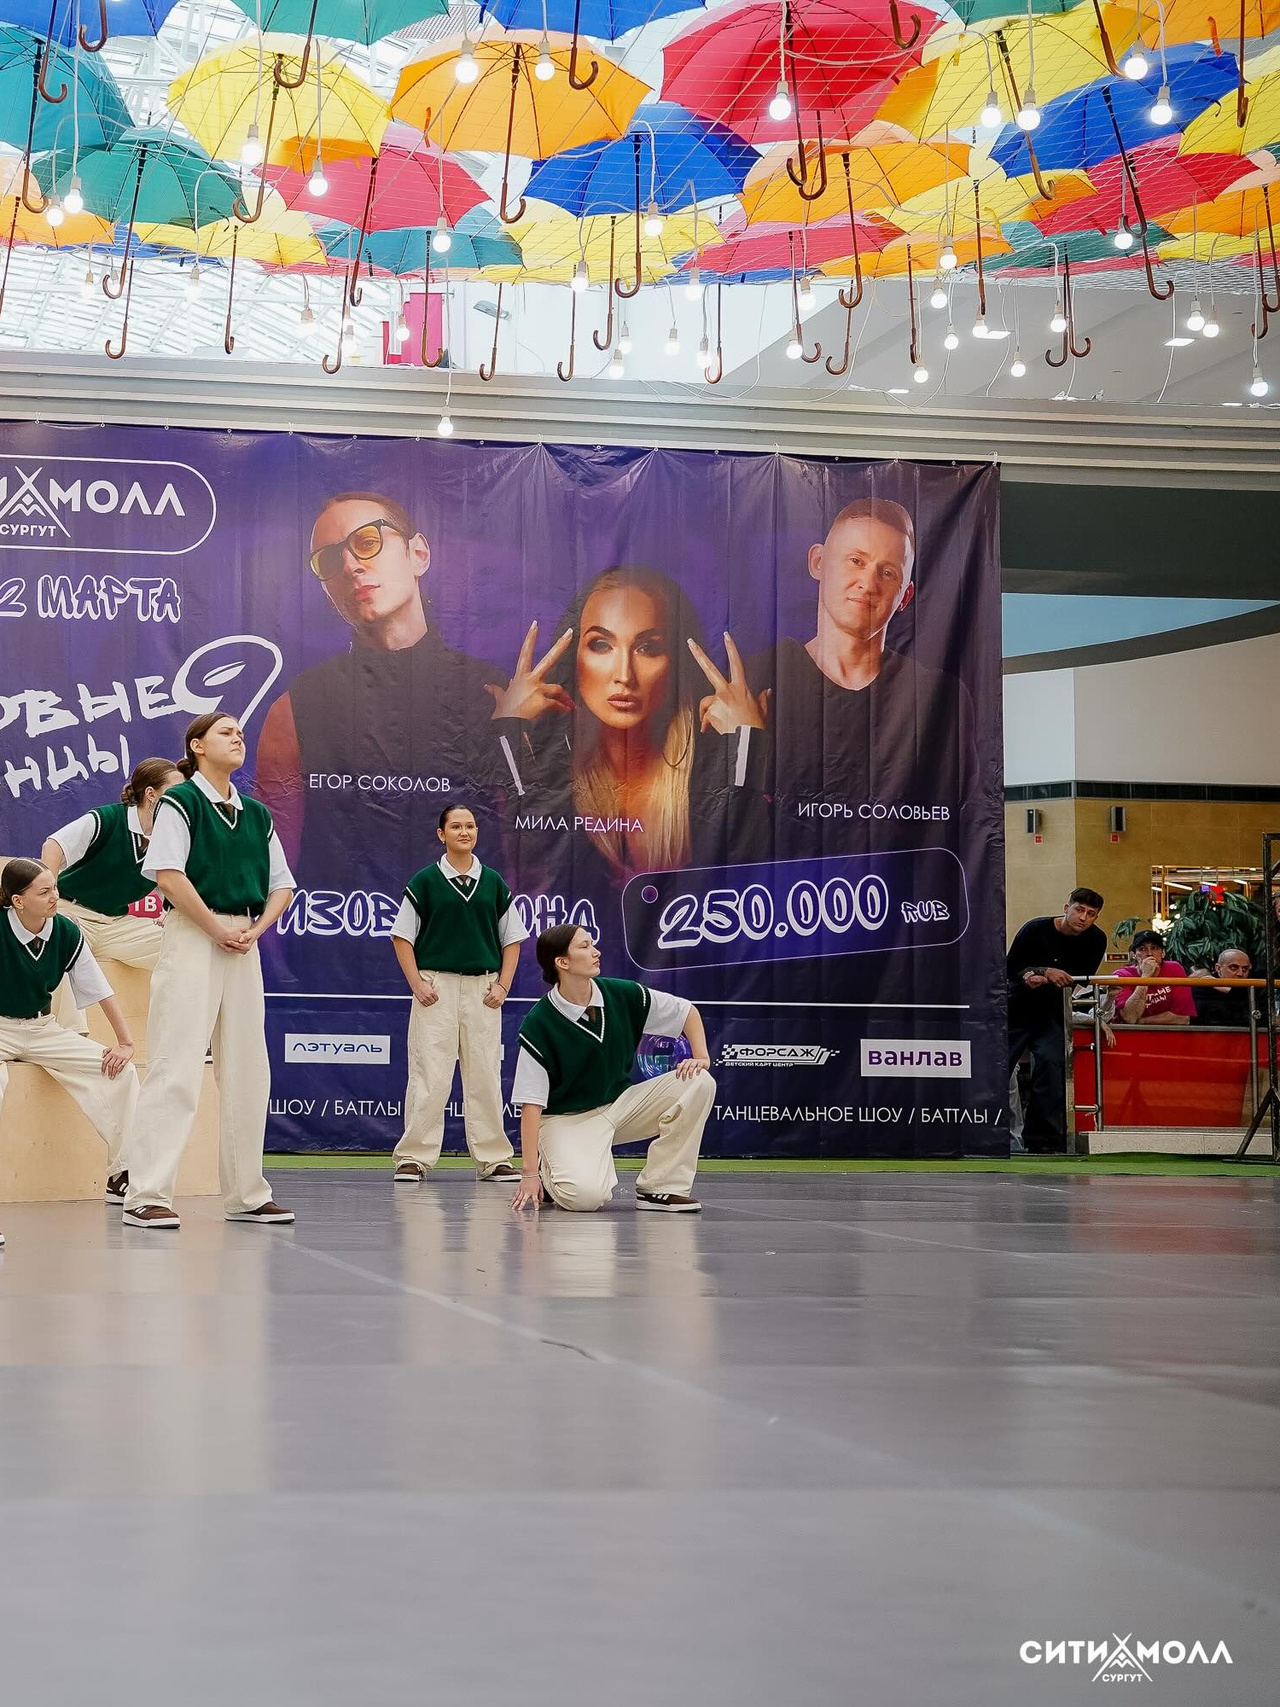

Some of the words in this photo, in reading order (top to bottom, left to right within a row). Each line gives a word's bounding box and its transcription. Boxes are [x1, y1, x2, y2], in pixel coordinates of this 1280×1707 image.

[36, 574, 182, 623] МАРТА
[309, 773, 353, 789] ЕГОР
[357, 774, 451, 793] СОКОЛОВ
[797, 802, 854, 819] ИГОРЬ
[858, 804, 951, 821] СОЛОВЬЕВ
[515, 814, 569, 832] МИЛА
[574, 816, 644, 834] РЕДИНА
[657, 874, 889, 950] 250.000
[900, 900, 951, 923] RUB
[739, 1047, 815, 1058] ФОРСАЖ
[867, 1049, 964, 1067] ванлав
[269, 1098, 316, 1115] ШОУ
[334, 1099, 401, 1117] БАТТЛЫ
[714, 1104, 854, 1124] ТАНЦЕВАЛЬНОЕ
[858, 1106, 904, 1123] ШОУ
[920, 1107, 989, 1124] БАТТЛЫ
